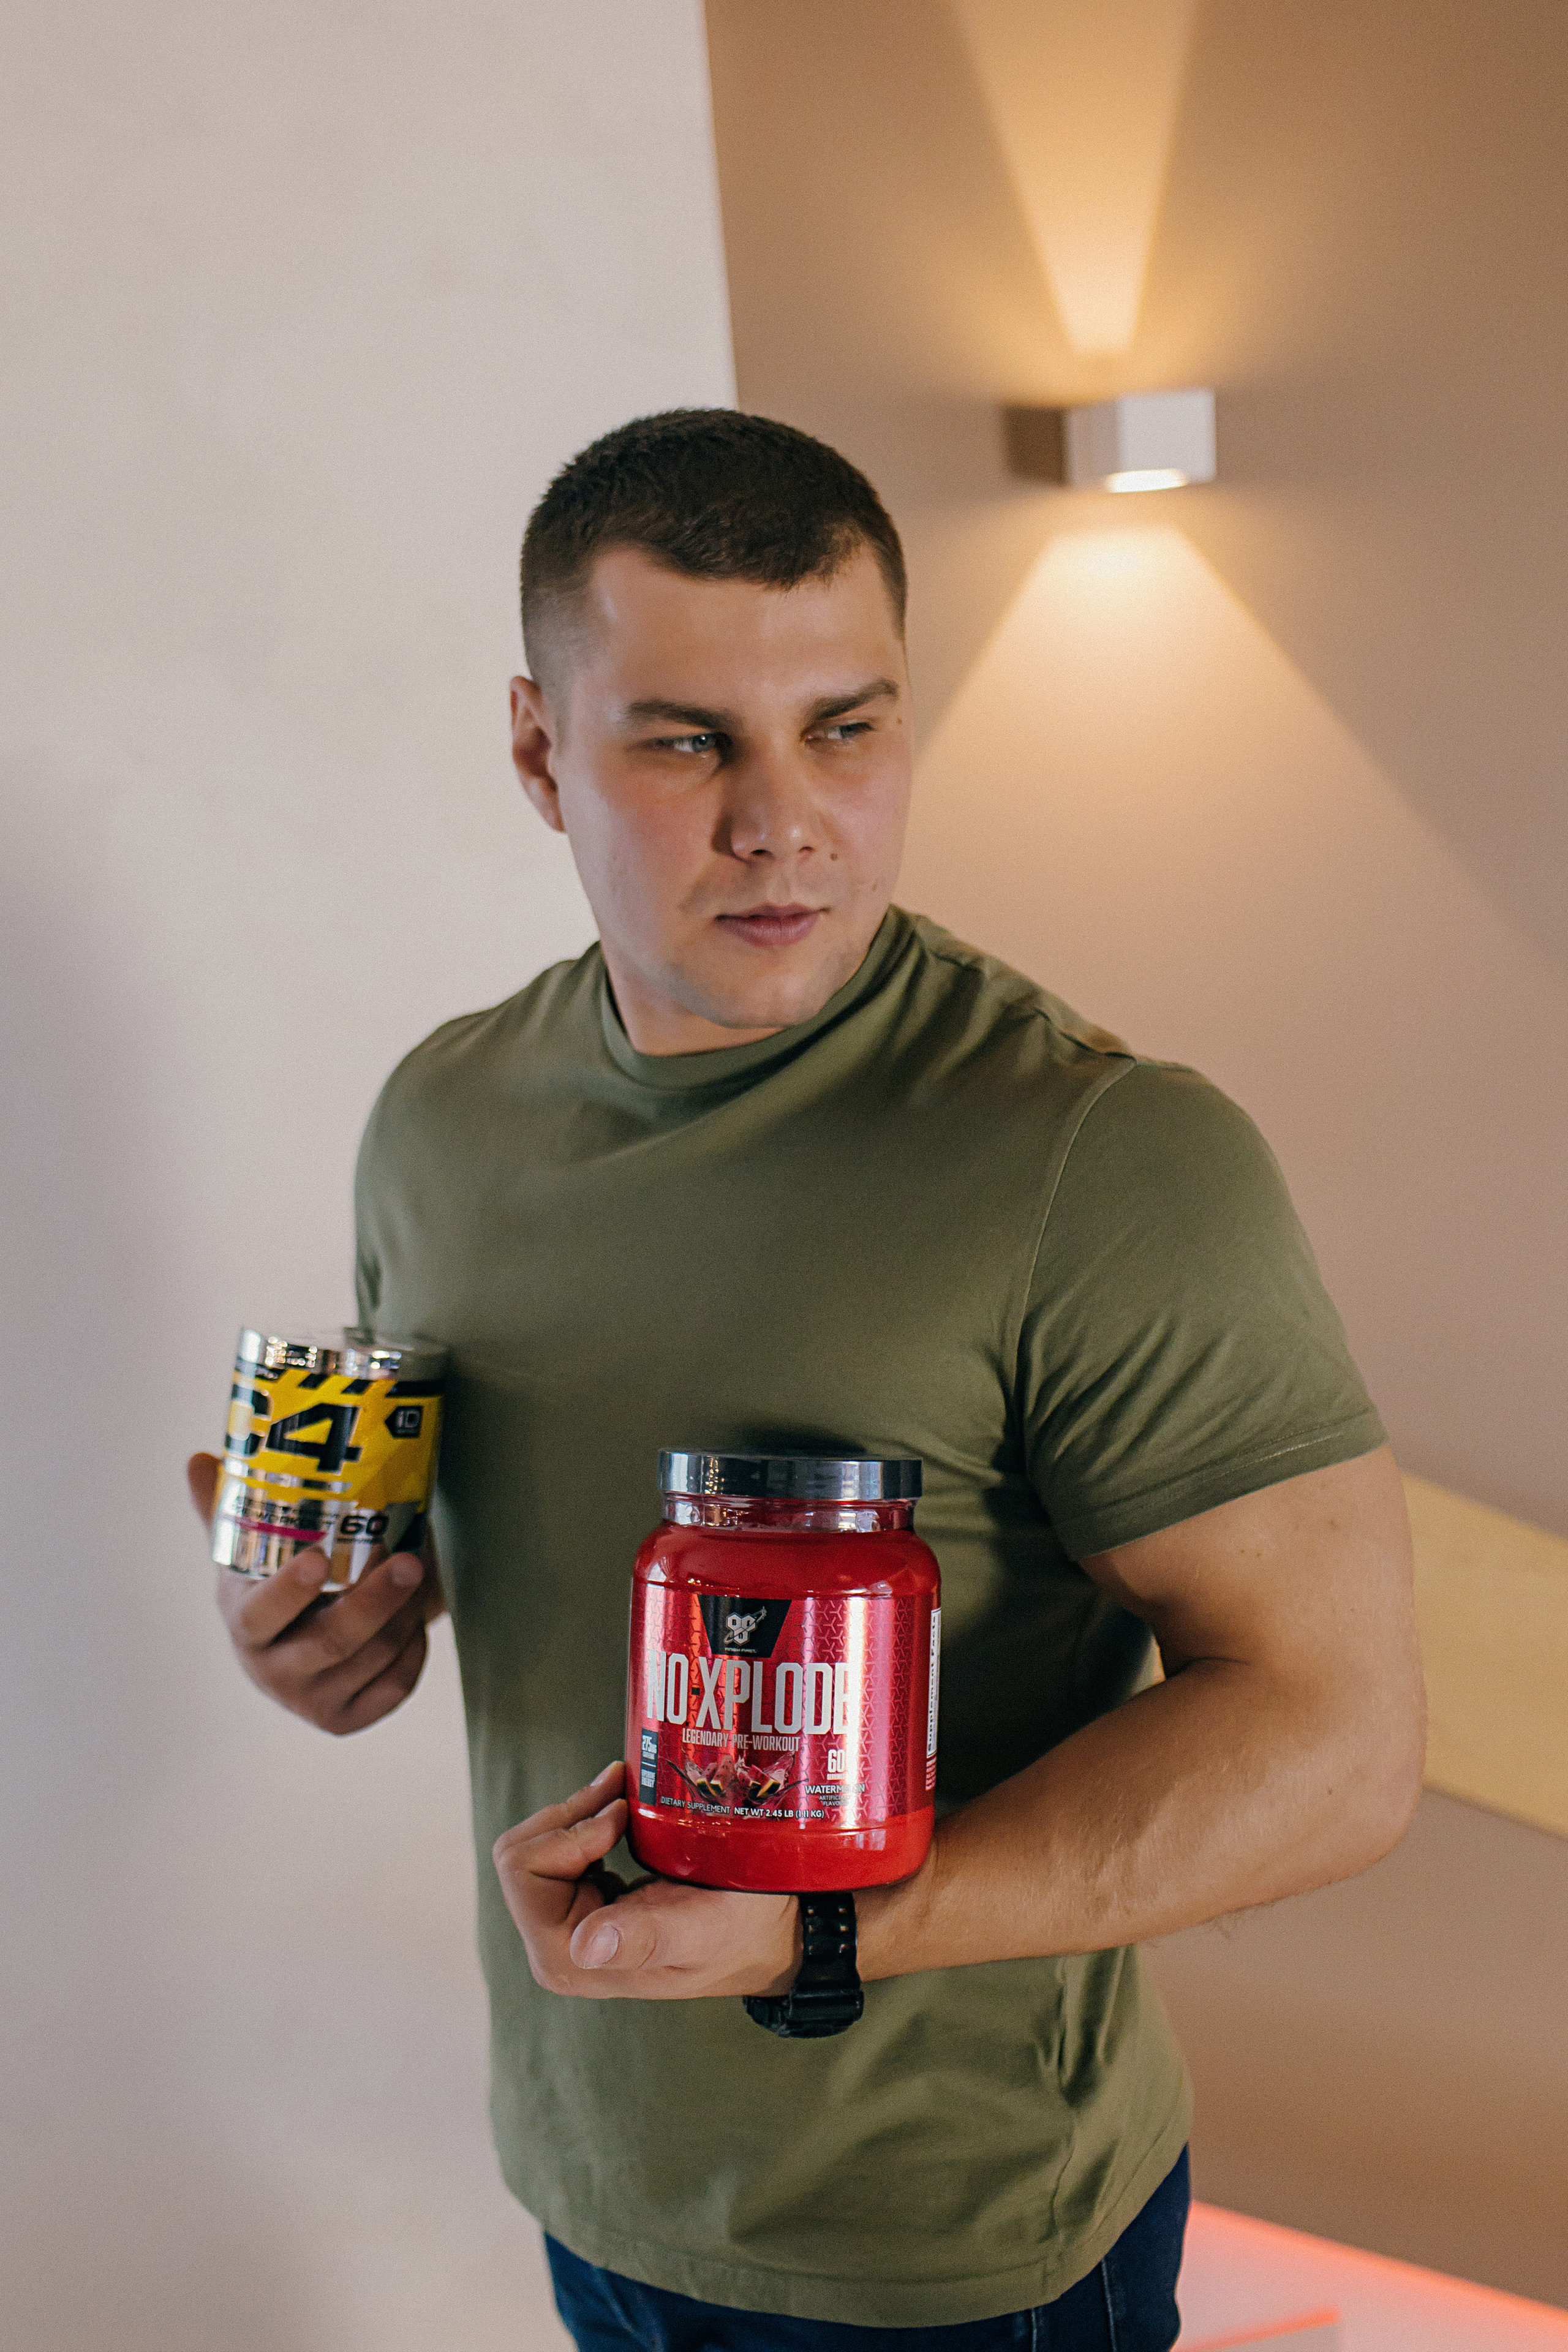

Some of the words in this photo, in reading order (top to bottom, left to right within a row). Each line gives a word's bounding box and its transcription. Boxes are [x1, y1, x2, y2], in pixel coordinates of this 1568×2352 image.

[341, 1515, 390, 1534] 60
[682, 1727, 729, 1748] LEGENDARY
[732, 1733, 800, 1752] PRE-WORKOUT
[827, 1749, 846, 1773] 60
[805, 1783, 865, 1795] WATERMON
[660, 1796, 686, 1807] DIETARY
[687, 1801, 731, 1814] SUPPLEMENT
[766, 1809, 782, 1817] 2.45
[810, 1810, 824, 1819] KG)
